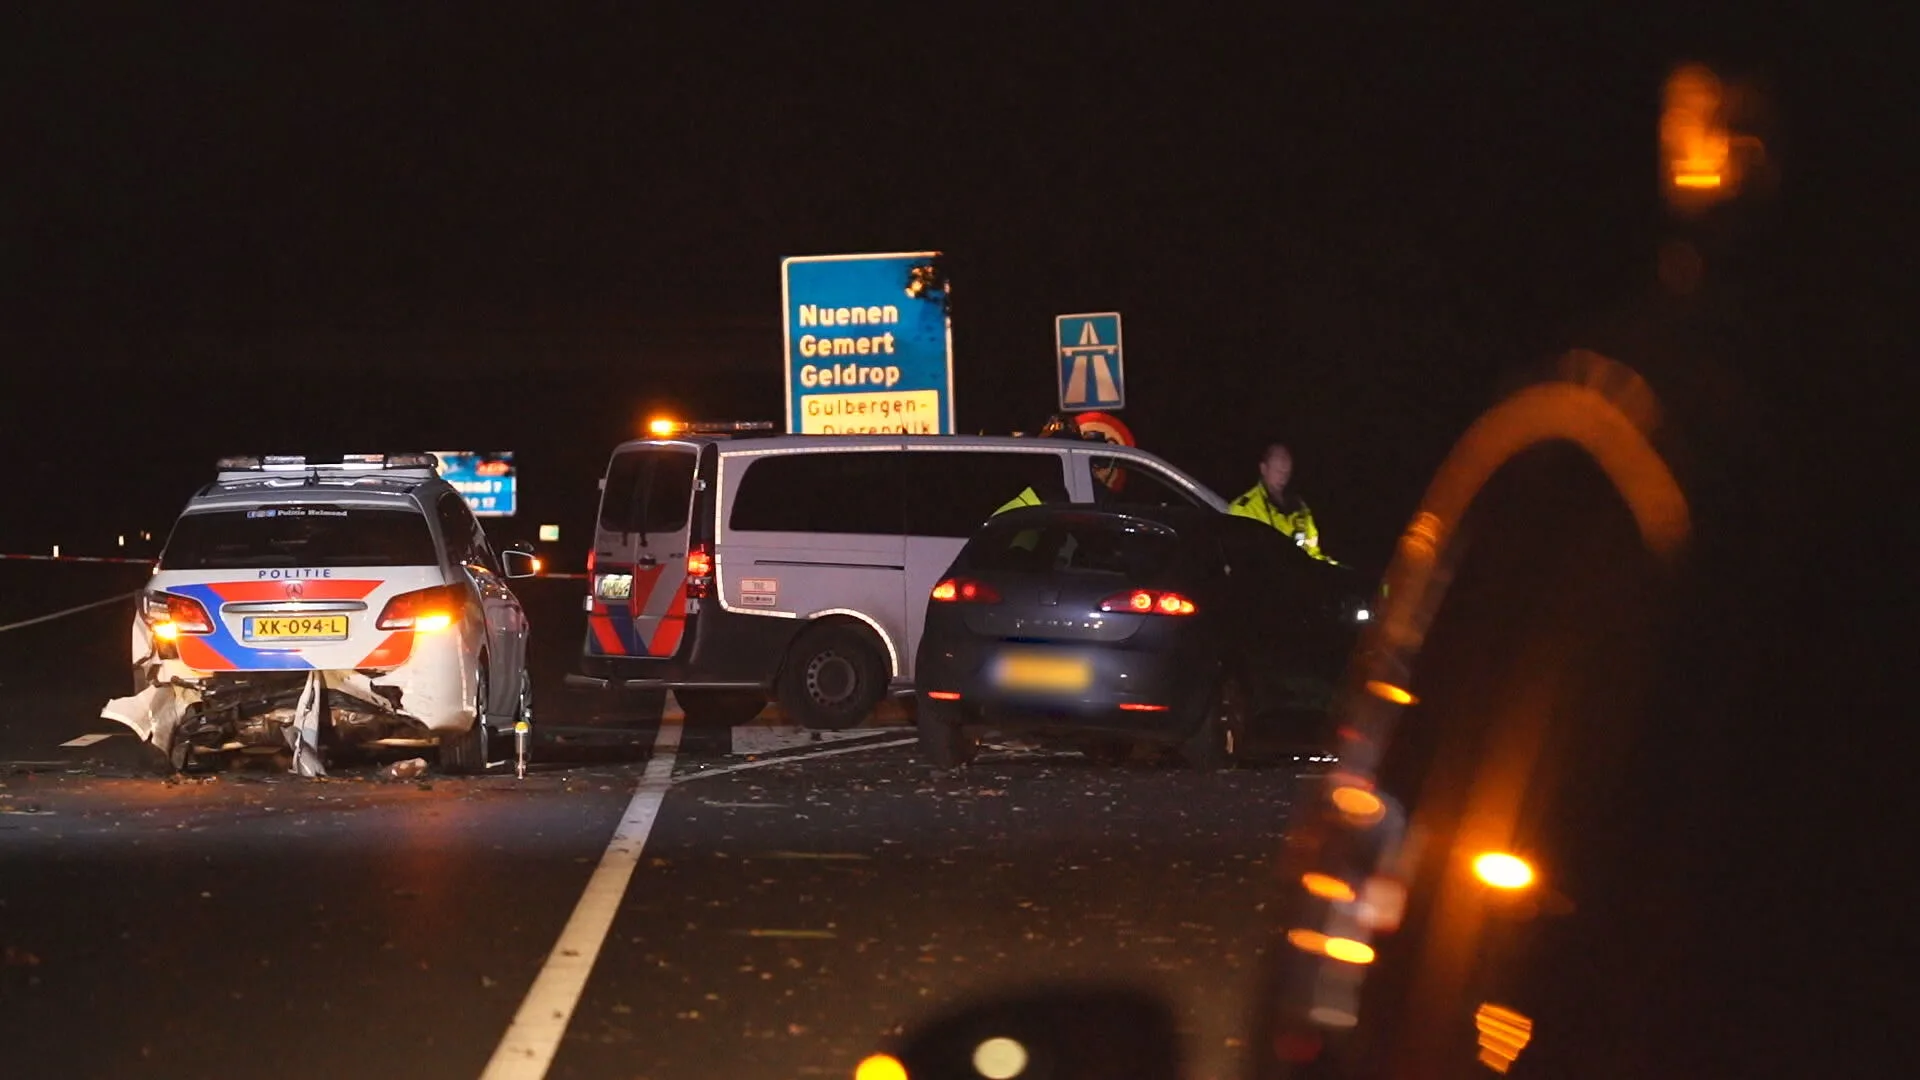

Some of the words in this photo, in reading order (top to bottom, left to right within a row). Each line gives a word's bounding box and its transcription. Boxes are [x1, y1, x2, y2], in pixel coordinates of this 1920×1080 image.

[799, 304, 898, 326] Nuenen
[799, 332, 895, 357] Gemert
[800, 363, 900, 387] Geldrop
[808, 400, 928, 418] Gulbergen-
[258, 569, 332, 579] POLITIE
[258, 619, 341, 635] XK-094-L
